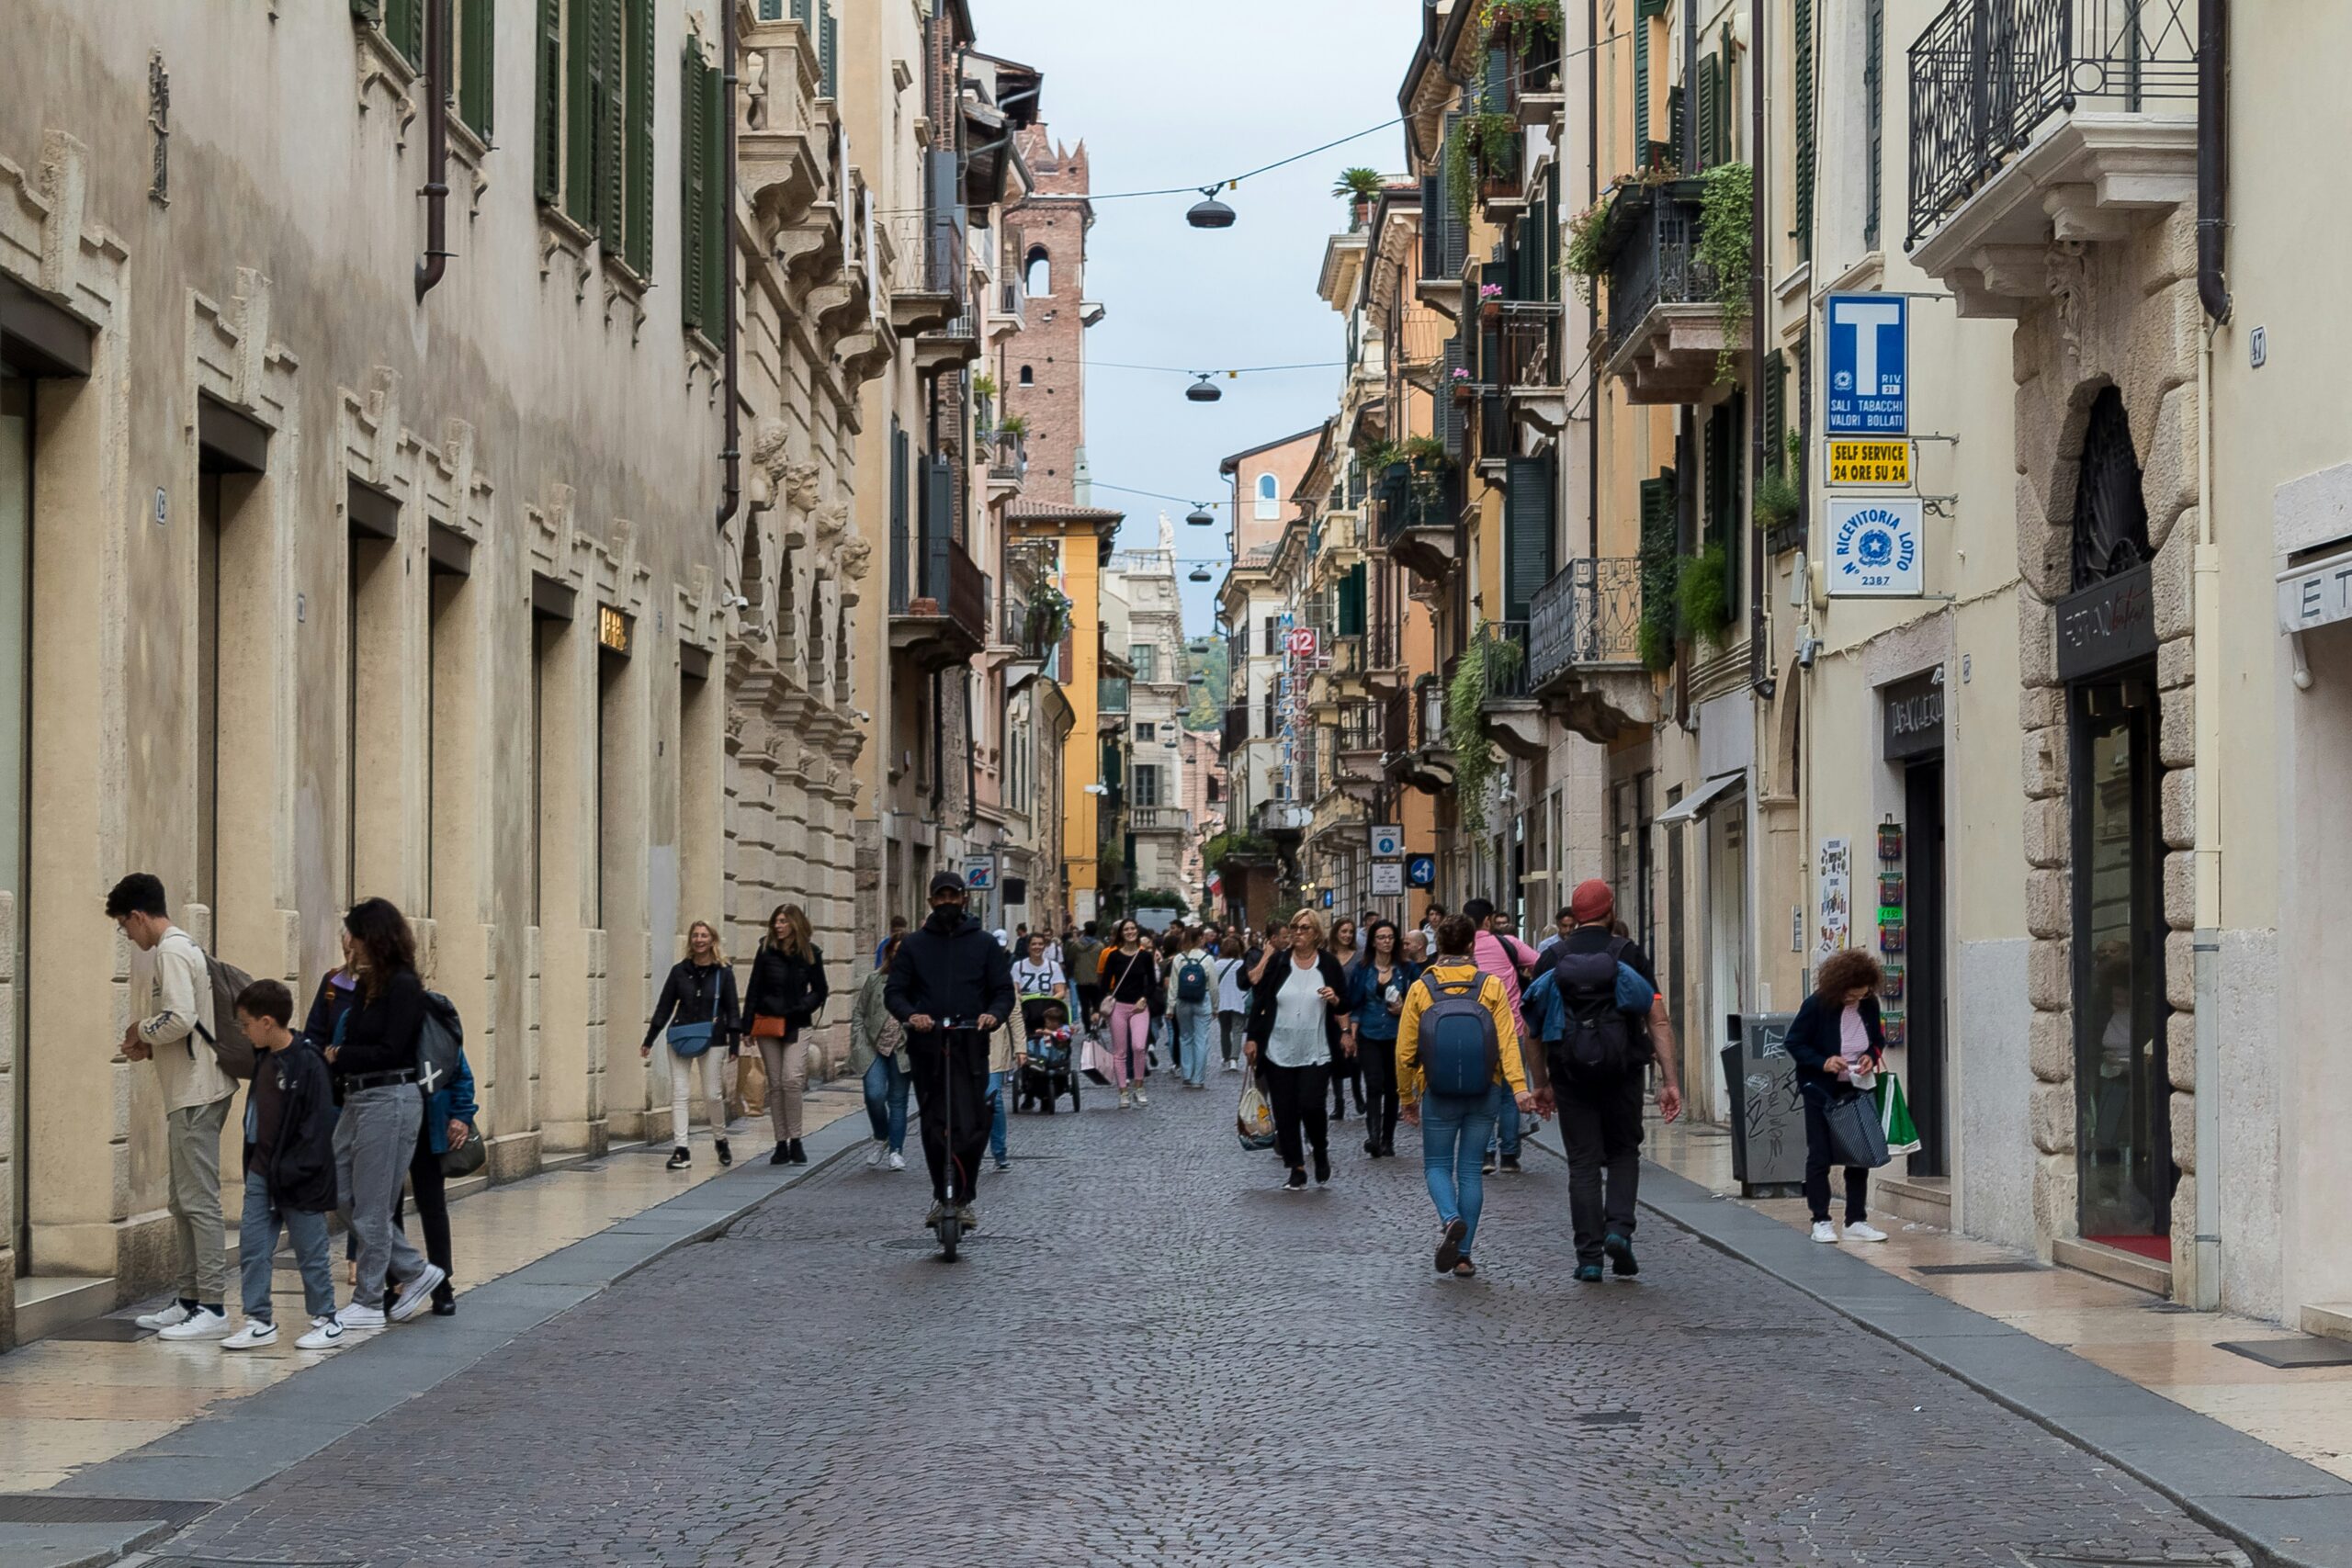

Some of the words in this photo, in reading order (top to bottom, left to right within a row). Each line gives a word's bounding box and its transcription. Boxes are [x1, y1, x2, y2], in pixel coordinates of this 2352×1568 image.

[1835, 303, 1900, 396] T
[1830, 400, 1851, 412] SALI
[1858, 400, 1903, 412] TABACCHI
[1830, 414, 1860, 426] VALORI
[1867, 415, 1903, 426] BOLLATI
[1835, 446, 1859, 460] SELF
[1861, 446, 1904, 461] SERVICE
[1833, 465, 1847, 480] 24
[1850, 465, 1871, 480] ORE
[1874, 465, 1889, 480] SU
[1892, 465, 1905, 480] 24
[1837, 509, 1901, 556] RICEVITORIA
[1896, 532, 1915, 571] LOTTO
[1861, 576, 1891, 586] 2387
[1289, 632, 1313, 651] 12
[1021, 972, 1051, 993] 78
